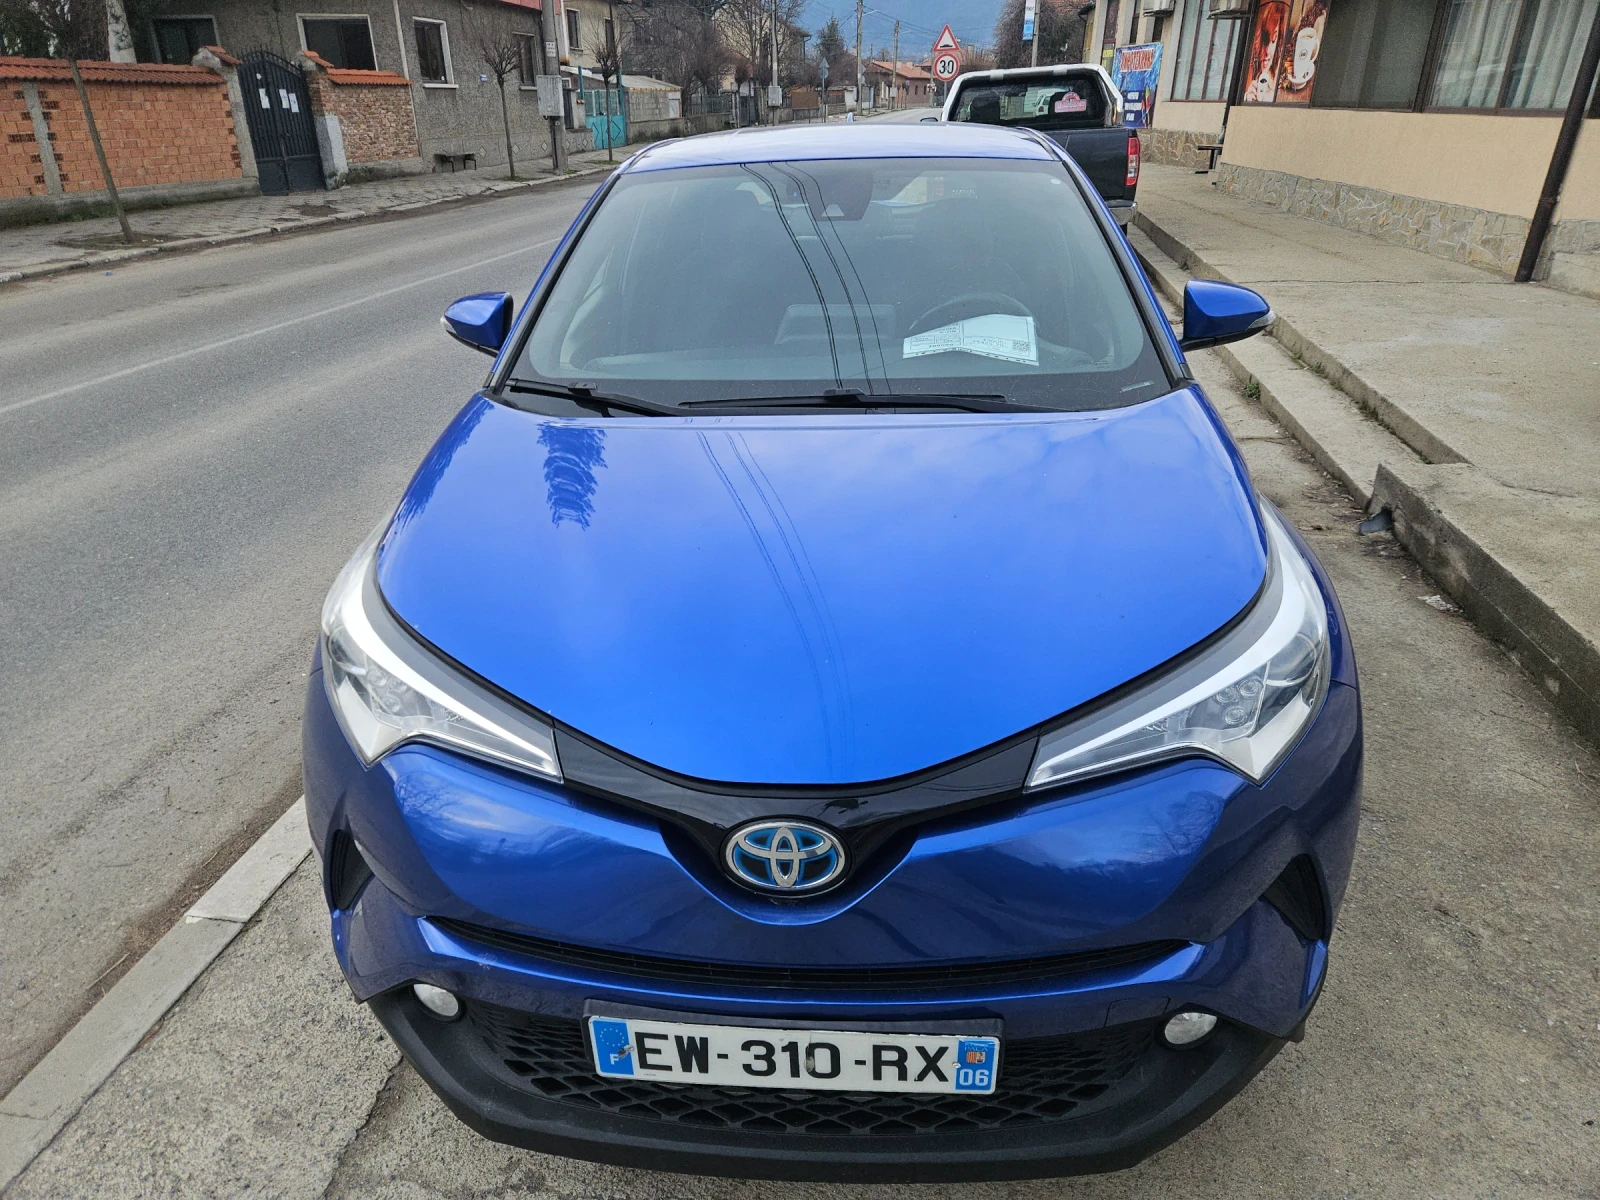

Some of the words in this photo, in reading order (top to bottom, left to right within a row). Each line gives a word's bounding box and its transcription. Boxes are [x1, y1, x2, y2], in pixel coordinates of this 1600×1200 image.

[939, 59, 955, 75] 30
[634, 1031, 949, 1083] EW-310-RX
[959, 1068, 990, 1087] 06
